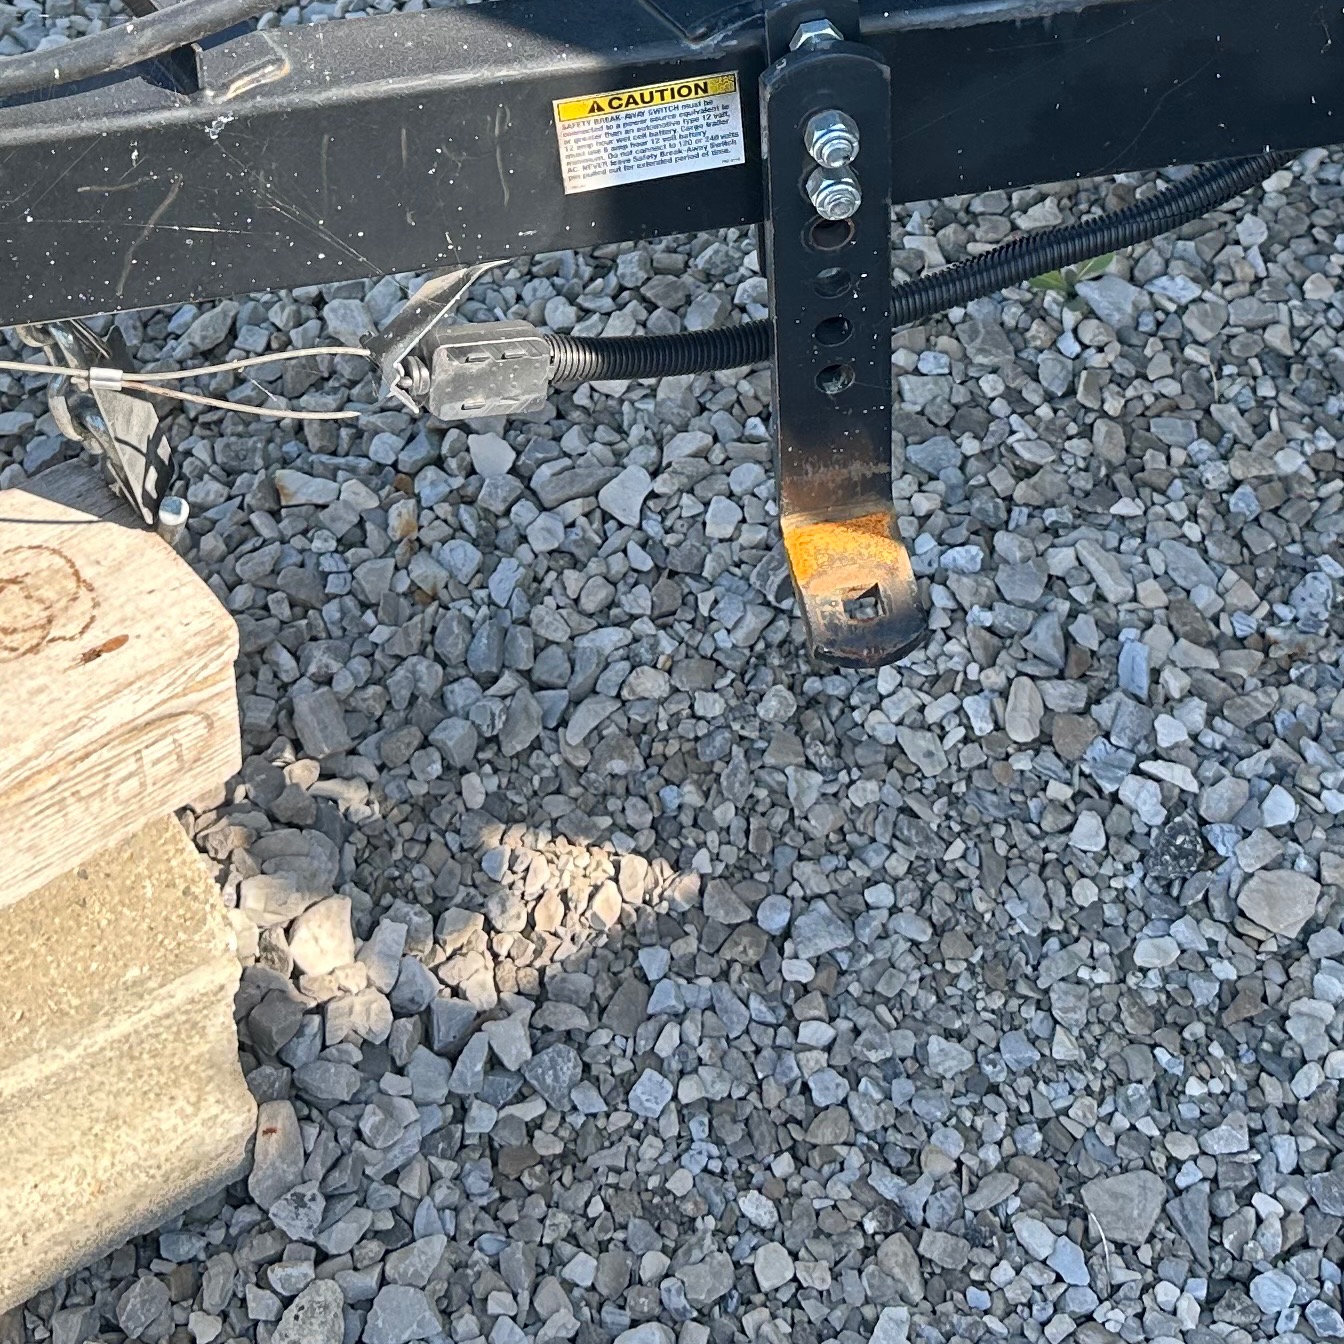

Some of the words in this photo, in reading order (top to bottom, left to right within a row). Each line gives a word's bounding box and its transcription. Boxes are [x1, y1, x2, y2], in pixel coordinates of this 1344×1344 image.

[607, 81, 708, 110] CAUTION
[561, 119, 591, 130] SAFETY
[647, 104, 678, 115] SWITCH
[681, 100, 701, 110] must
[562, 125, 603, 137] connected
[622, 118, 647, 128] power
[649, 113, 676, 122] source
[678, 105, 719, 118] equivalent
[573, 133, 601, 144] greater
[604, 129, 622, 137] than
[636, 119, 680, 132] automotive
[682, 116, 699, 125] type
[576, 141, 593, 150] amp
[595, 138, 612, 146] hour
[632, 132, 646, 140] cell
[681, 123, 703, 132] Cargo
[706, 118, 729, 127] trailer
[610, 143, 628, 152] amp
[678, 130, 706, 140] battery
[582, 161, 607, 170] NEVER
[610, 157, 630, 165] leave
[633, 152, 657, 163] Safety
[709, 139, 736, 148] Switch
[619, 149, 632, 157] not
[634, 143, 666, 154] connect
[678, 139, 692, 147] 120
[568, 173, 580, 181] pin
[582, 168, 606, 179] pulled
[636, 157, 672, 168] extended
[674, 152, 699, 163] period
